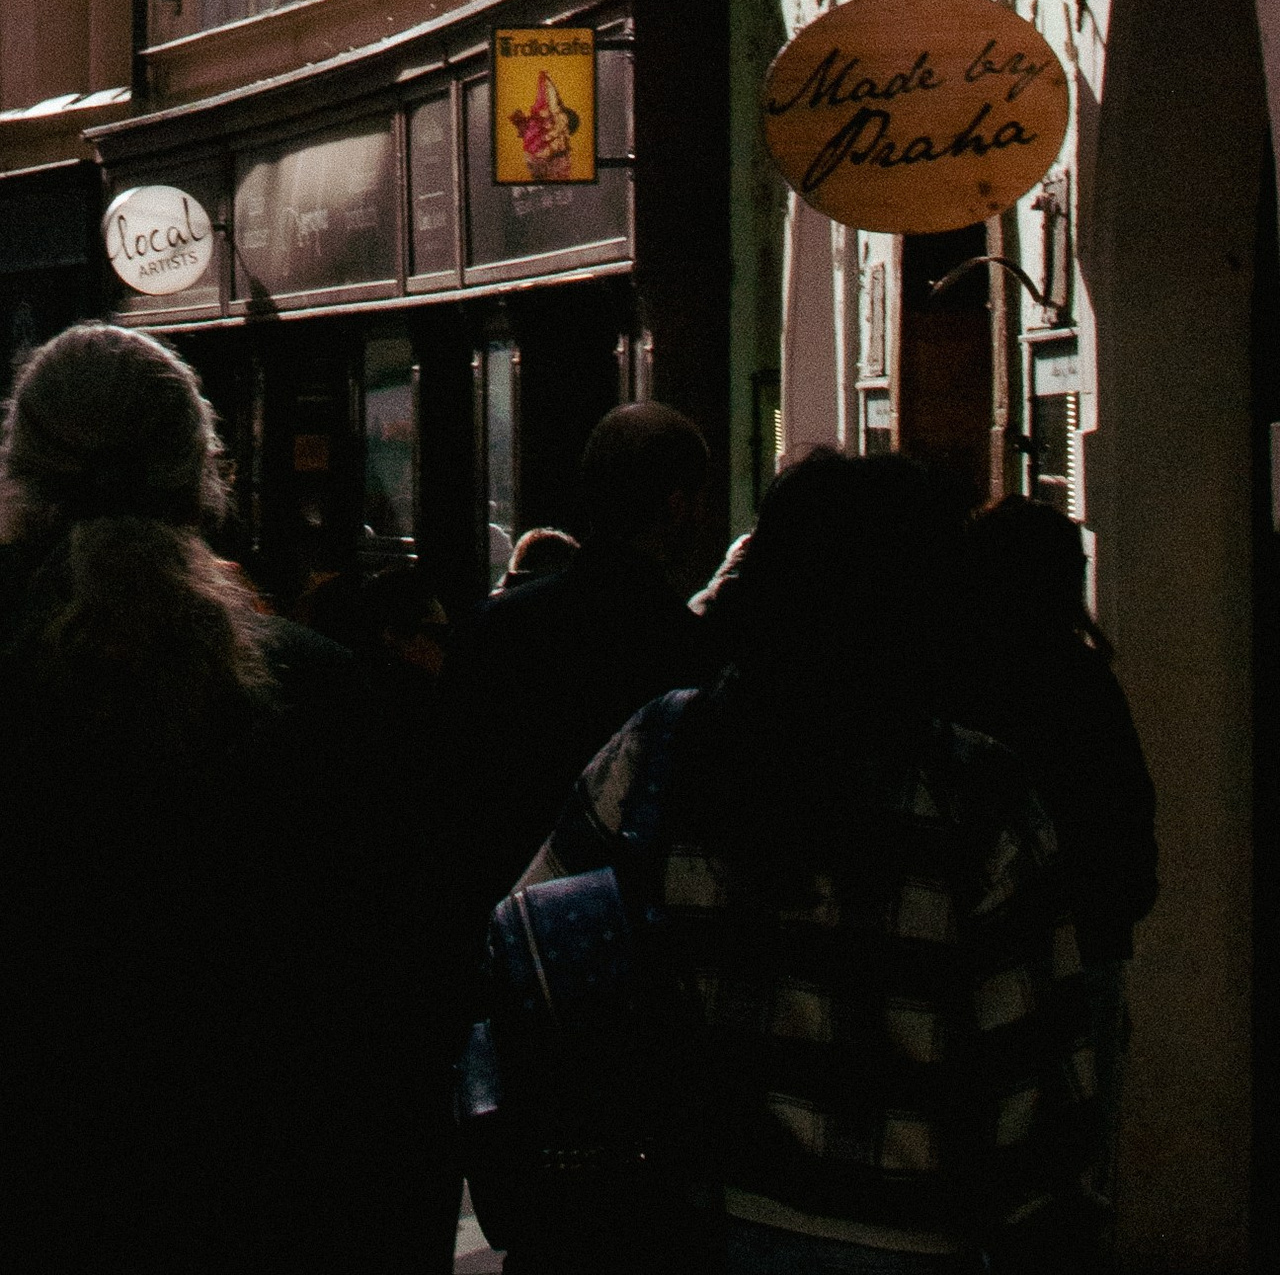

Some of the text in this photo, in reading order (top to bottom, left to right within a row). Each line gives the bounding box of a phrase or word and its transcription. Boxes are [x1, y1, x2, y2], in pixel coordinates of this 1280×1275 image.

[769, 47, 942, 116] Made
[801, 103, 1037, 193] Praha
[108, 196, 210, 260] local
[138, 250, 198, 279] ARTISTS
